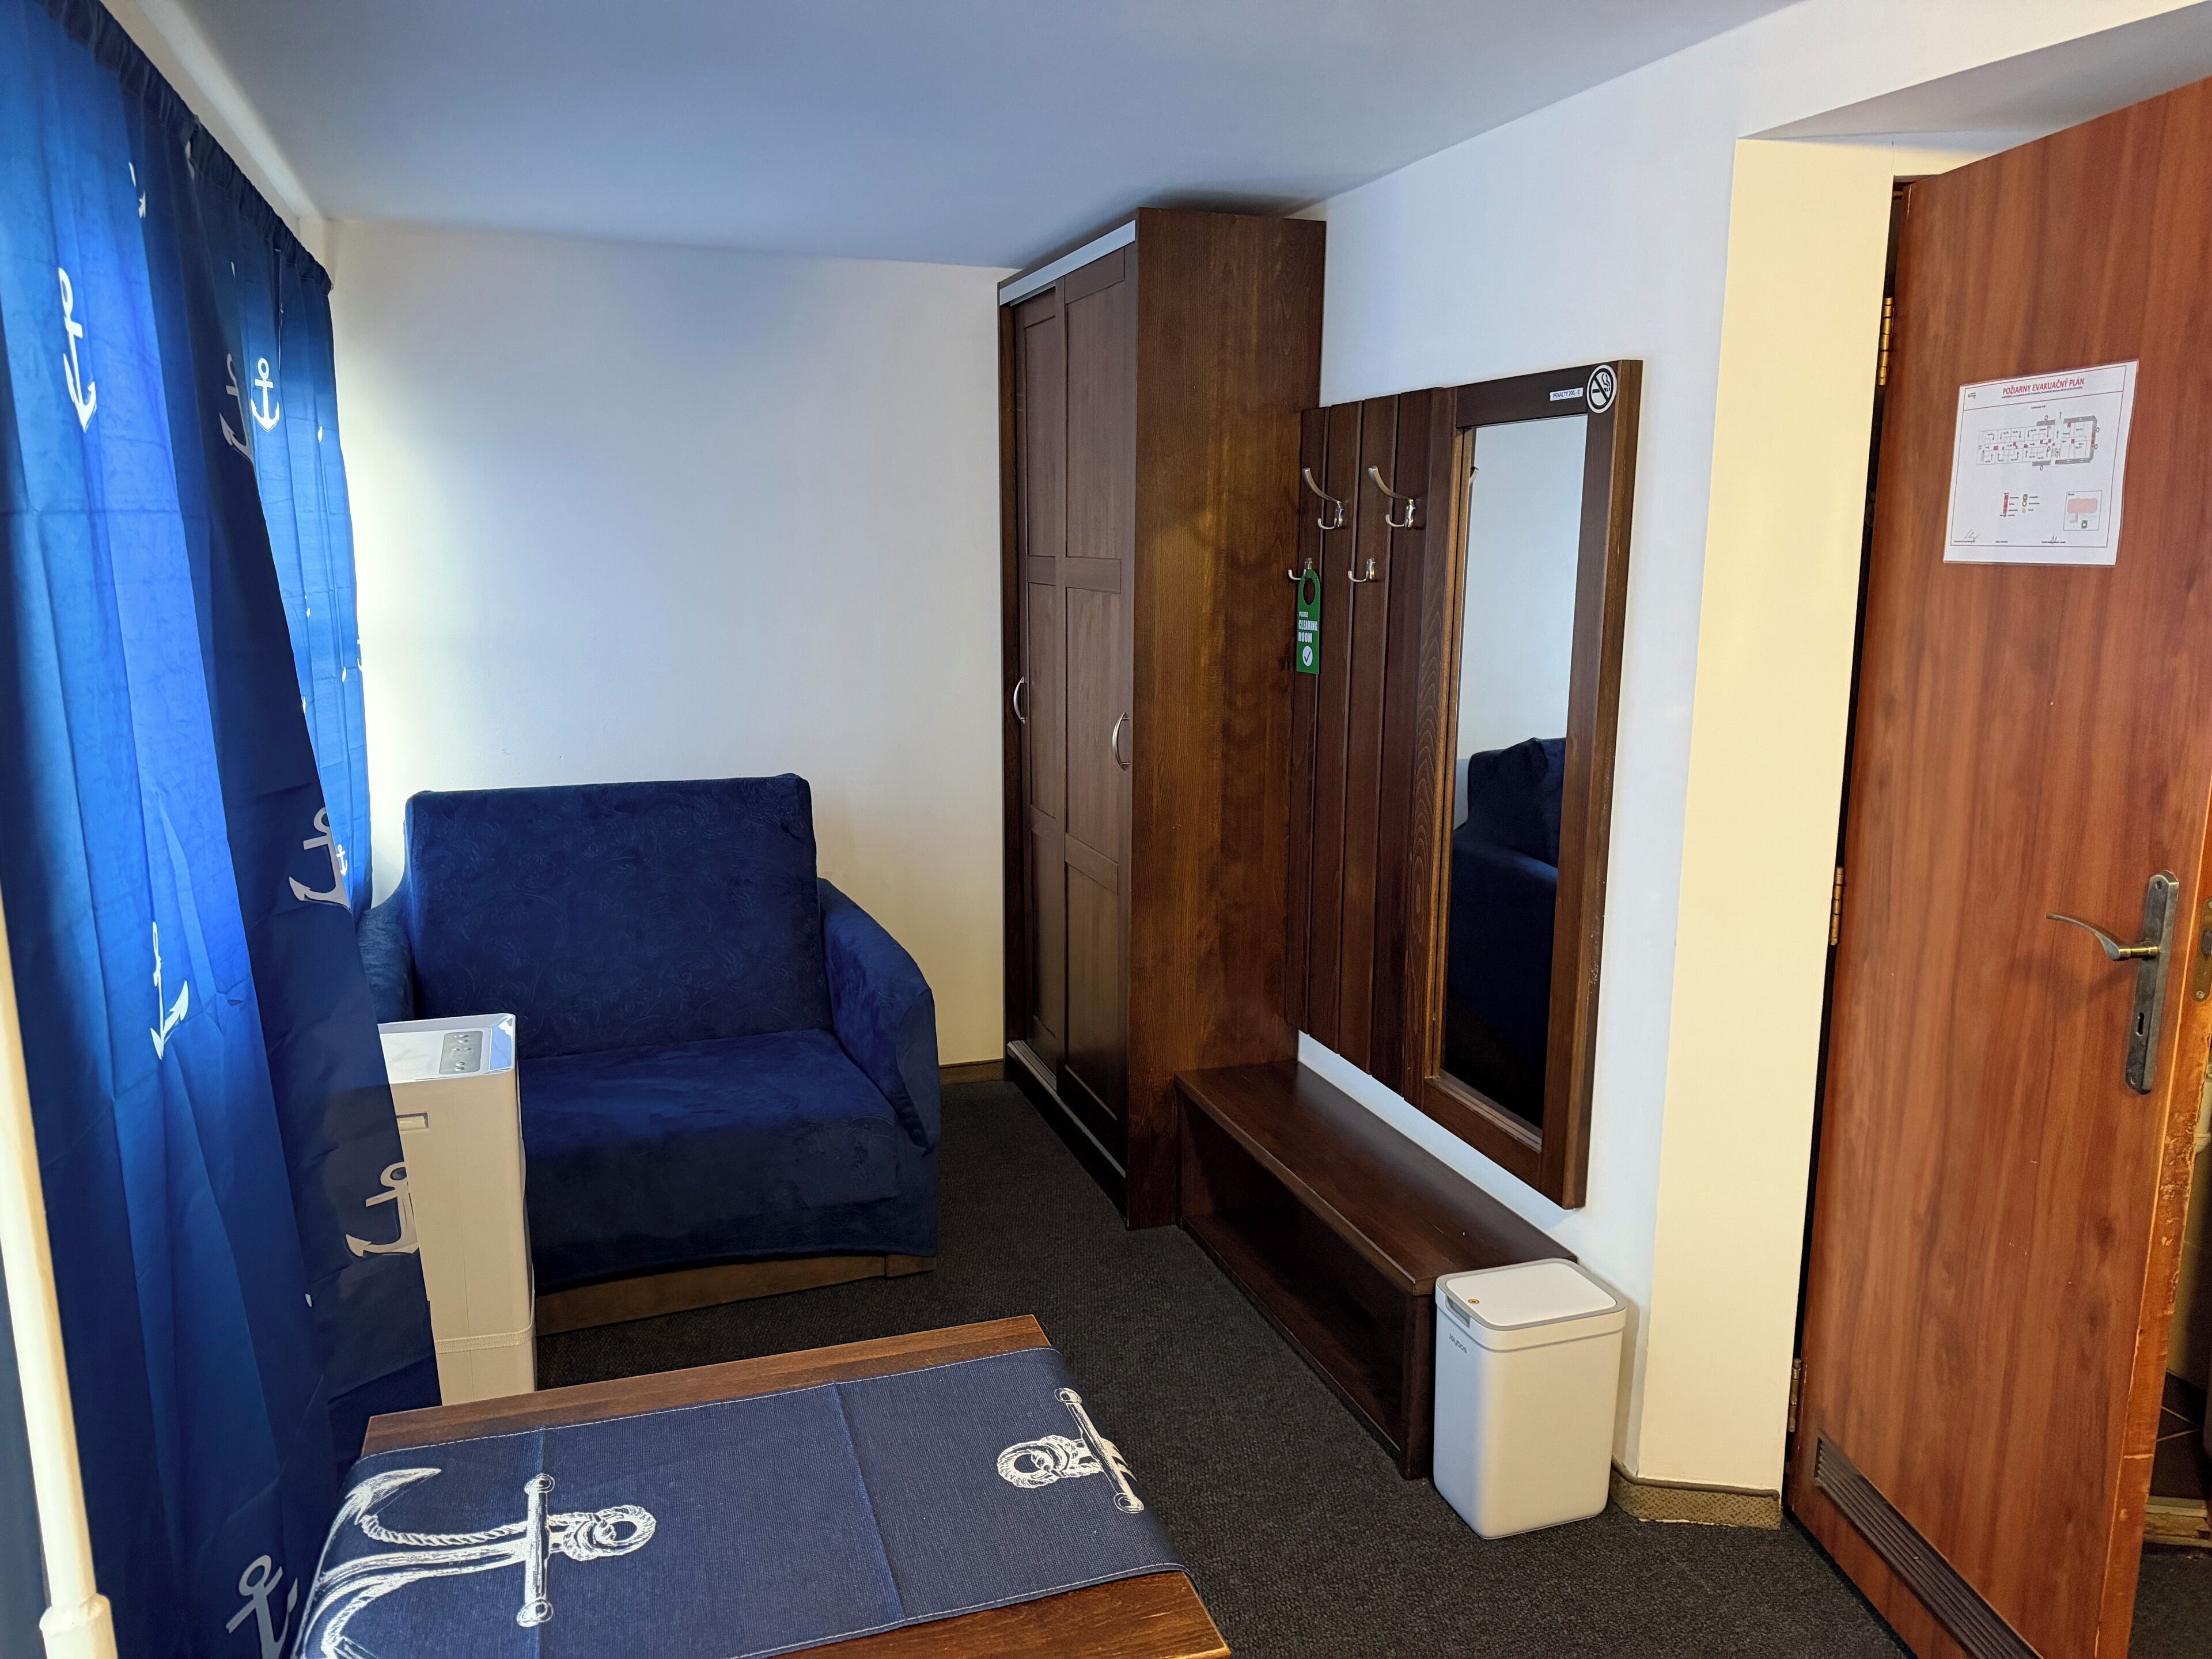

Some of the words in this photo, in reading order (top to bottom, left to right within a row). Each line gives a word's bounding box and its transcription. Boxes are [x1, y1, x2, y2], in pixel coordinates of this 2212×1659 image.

[2002, 385, 2031, 395] POŽIARNY
[2032, 379, 2068, 391] EVAKUAČNÝ
[2069, 377, 2085, 387] PLÁN
[1298, 620, 1317, 631] CLEANING
[1298, 632, 1312, 643] ROOM
